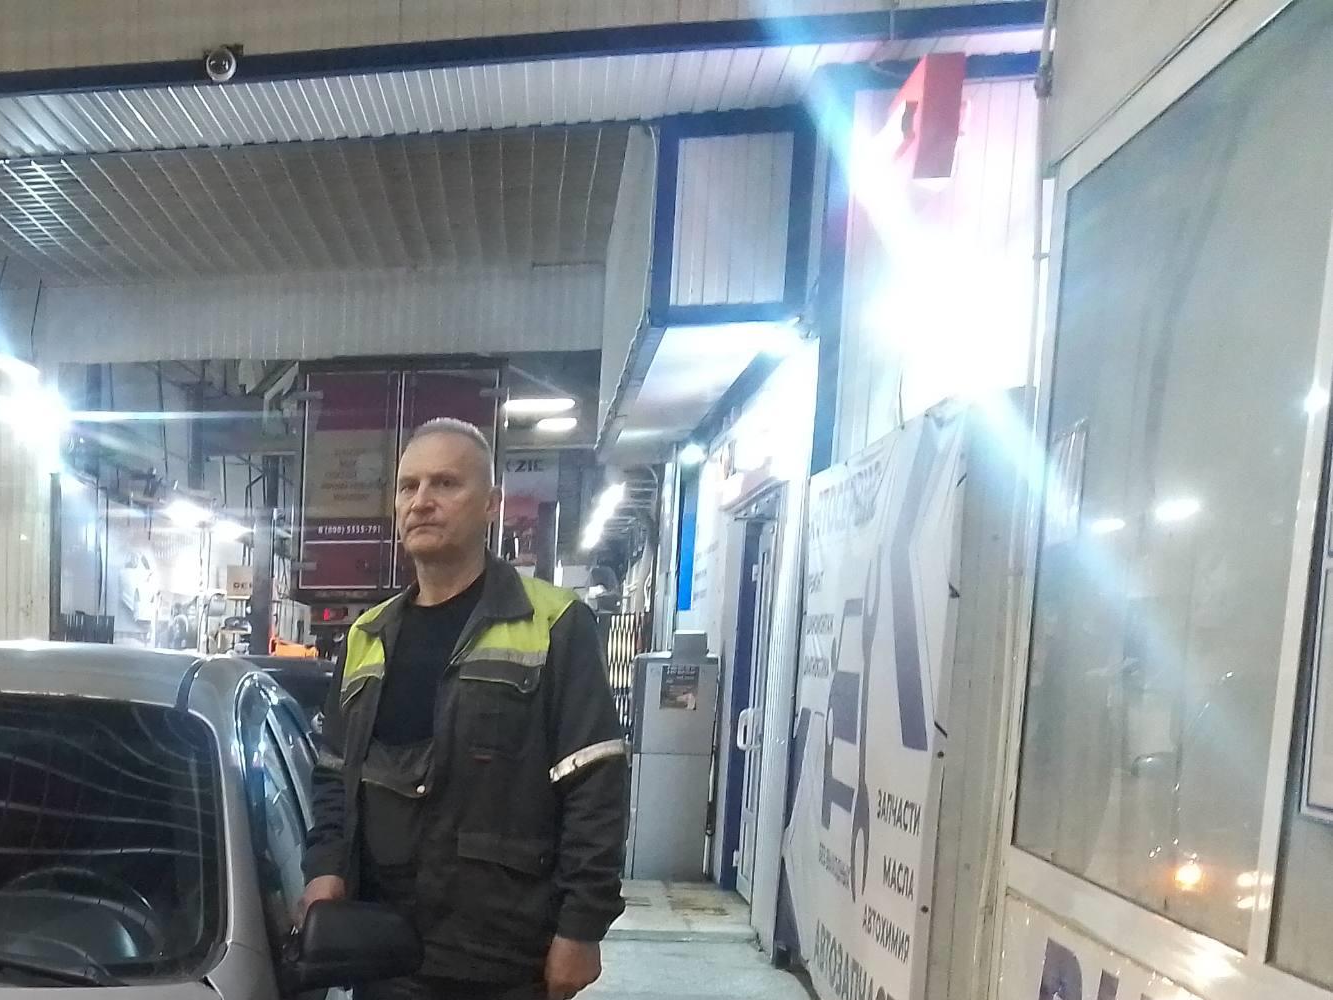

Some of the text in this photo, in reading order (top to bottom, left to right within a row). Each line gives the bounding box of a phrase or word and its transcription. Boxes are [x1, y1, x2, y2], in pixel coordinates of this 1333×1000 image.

[877, 788, 921, 837] ЗАПЧАСТИ
[883, 855, 915, 901] МАСЛА
[863, 904, 910, 964] АВТОХИМИЯ
